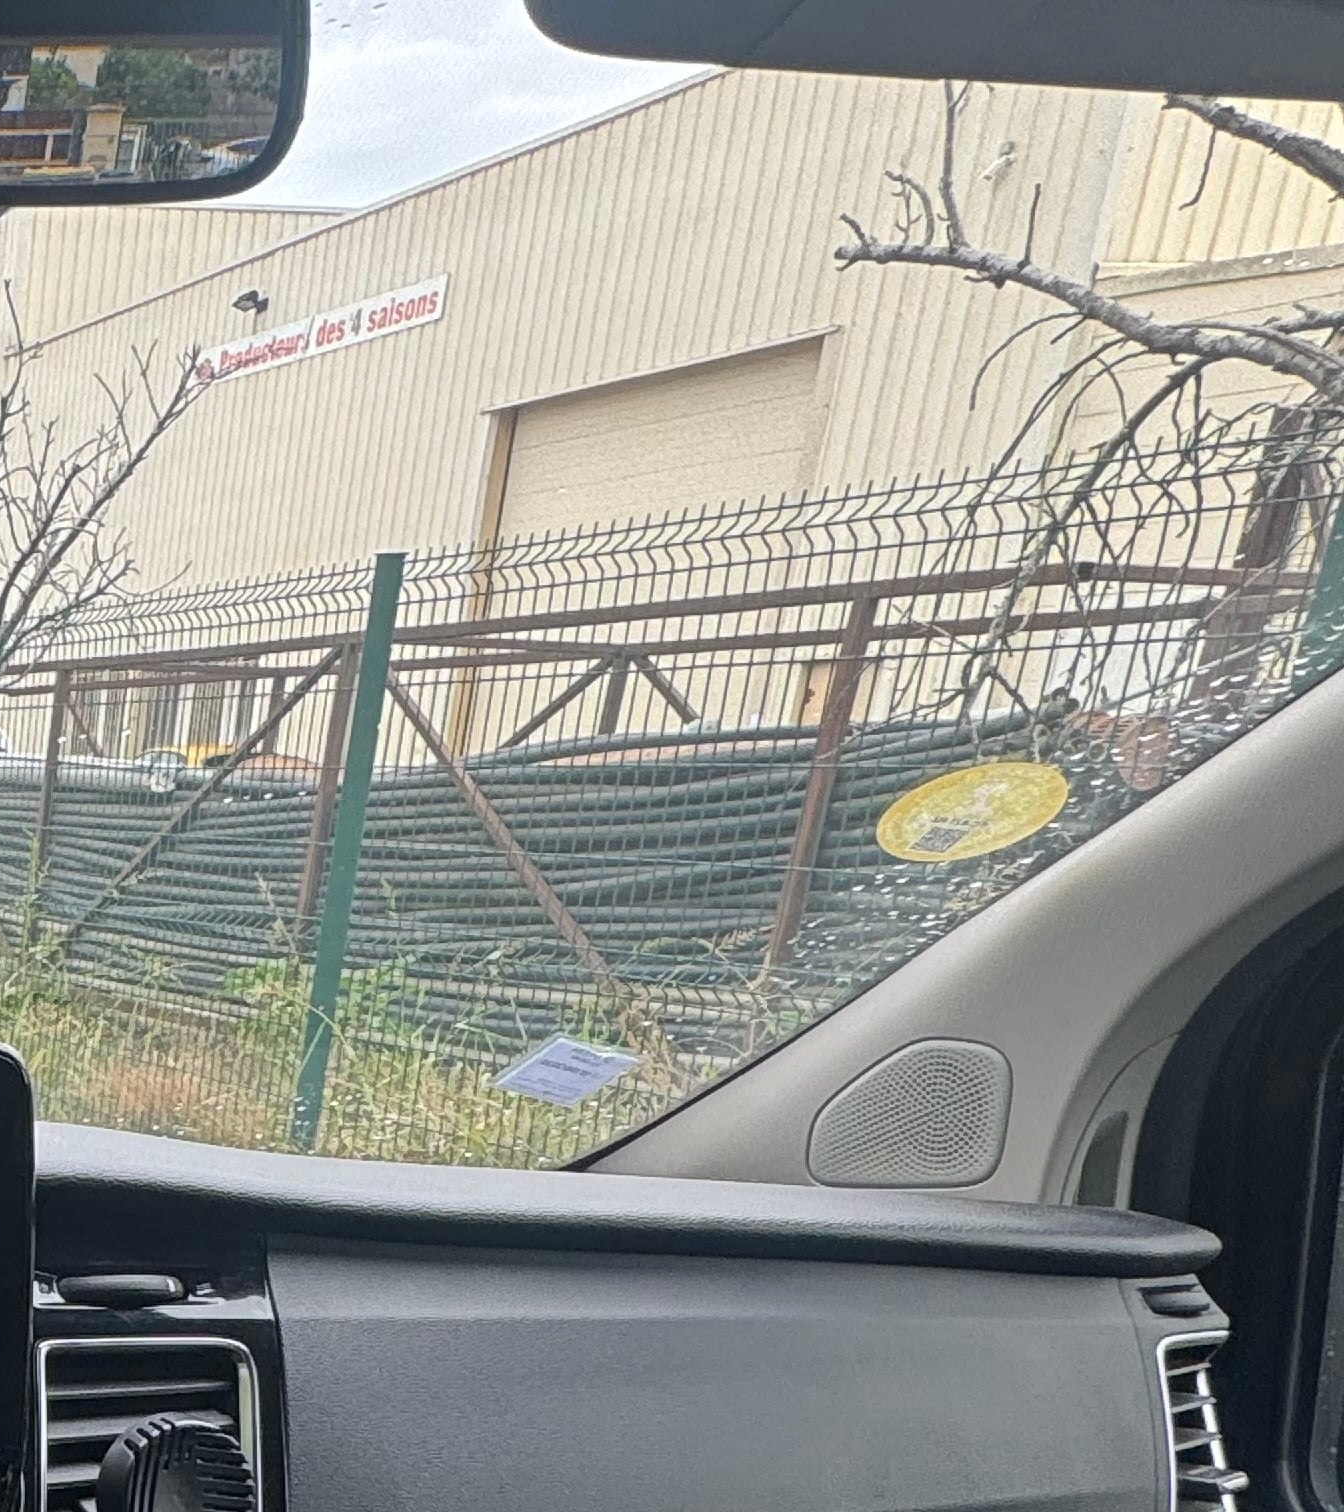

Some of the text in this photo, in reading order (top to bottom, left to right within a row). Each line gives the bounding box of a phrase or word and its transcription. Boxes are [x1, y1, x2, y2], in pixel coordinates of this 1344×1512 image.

[315, 318, 346, 348] des
[350, 307, 363, 337] 4
[367, 290, 440, 333] saisons
